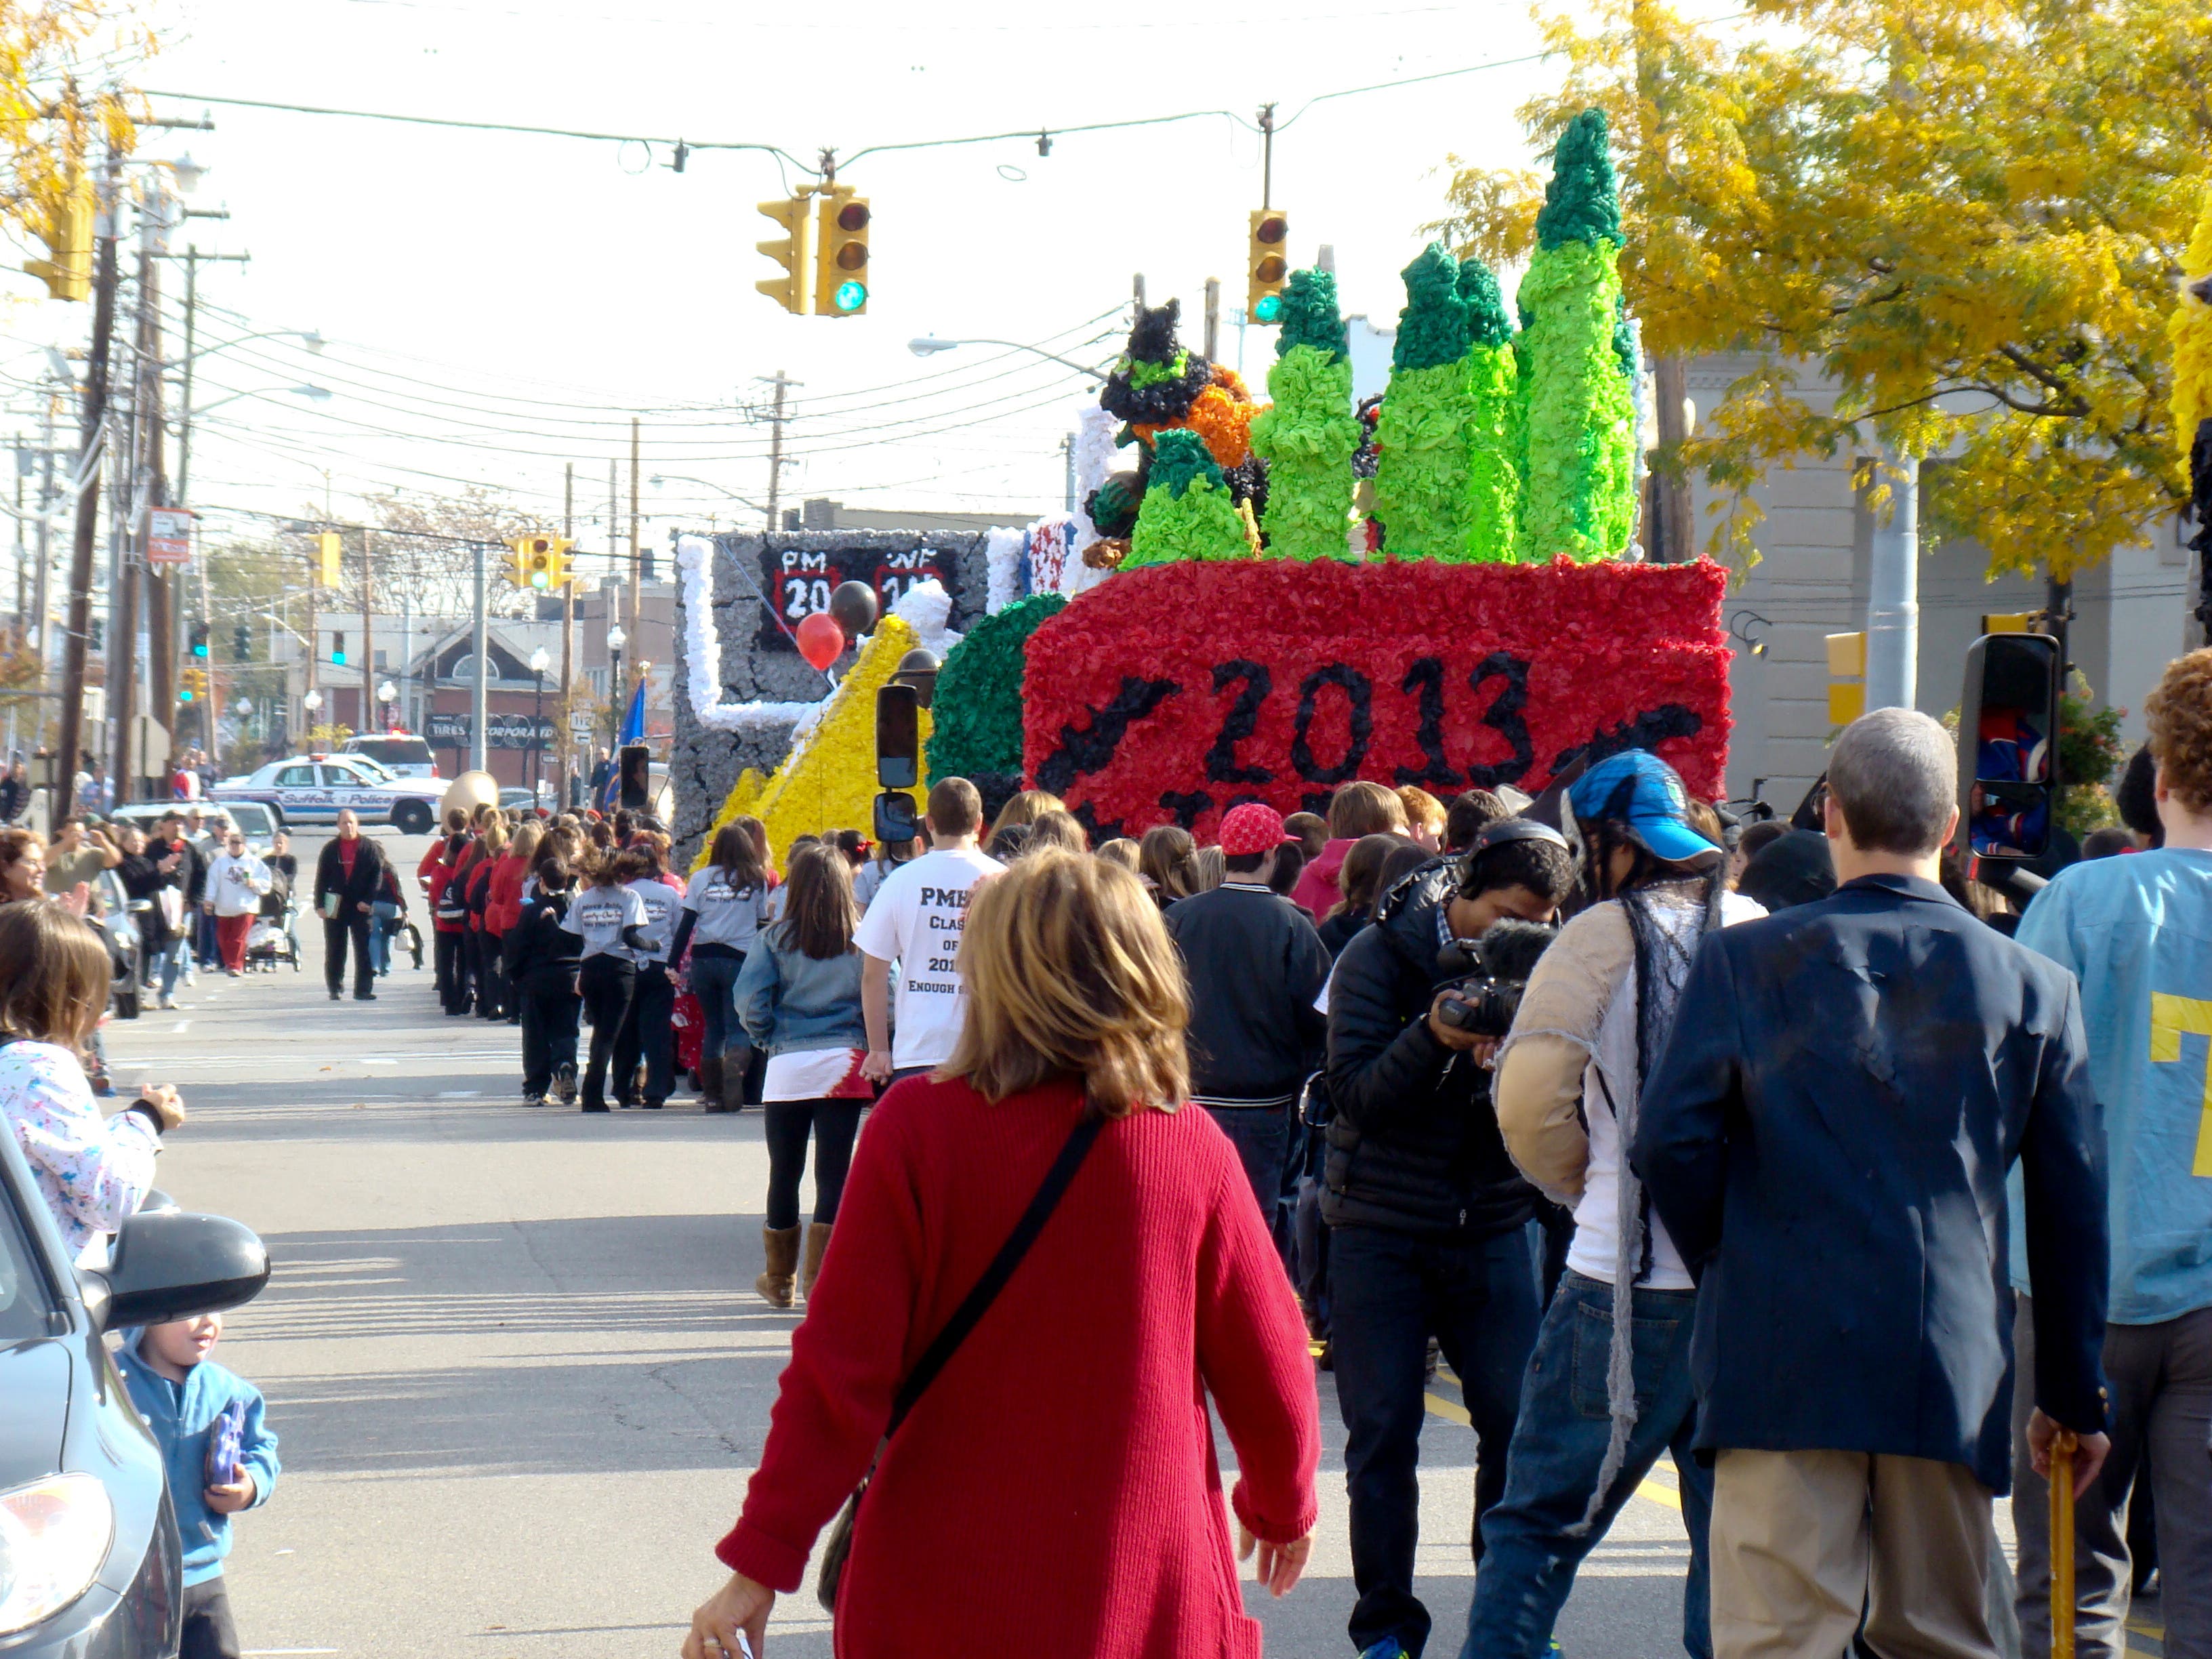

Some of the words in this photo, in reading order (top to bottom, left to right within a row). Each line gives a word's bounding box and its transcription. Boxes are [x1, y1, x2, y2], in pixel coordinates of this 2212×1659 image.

[781, 550, 827, 575] PM
[785, 577, 832, 618] 20
[432, 724, 466, 736] TIRES
[1206, 651, 1533, 788] 2013
[284, 794, 336, 804] Suffolk
[348, 794, 392, 804] Police
[920, 887, 969, 908] PMH
[928, 958, 956, 972] 201
